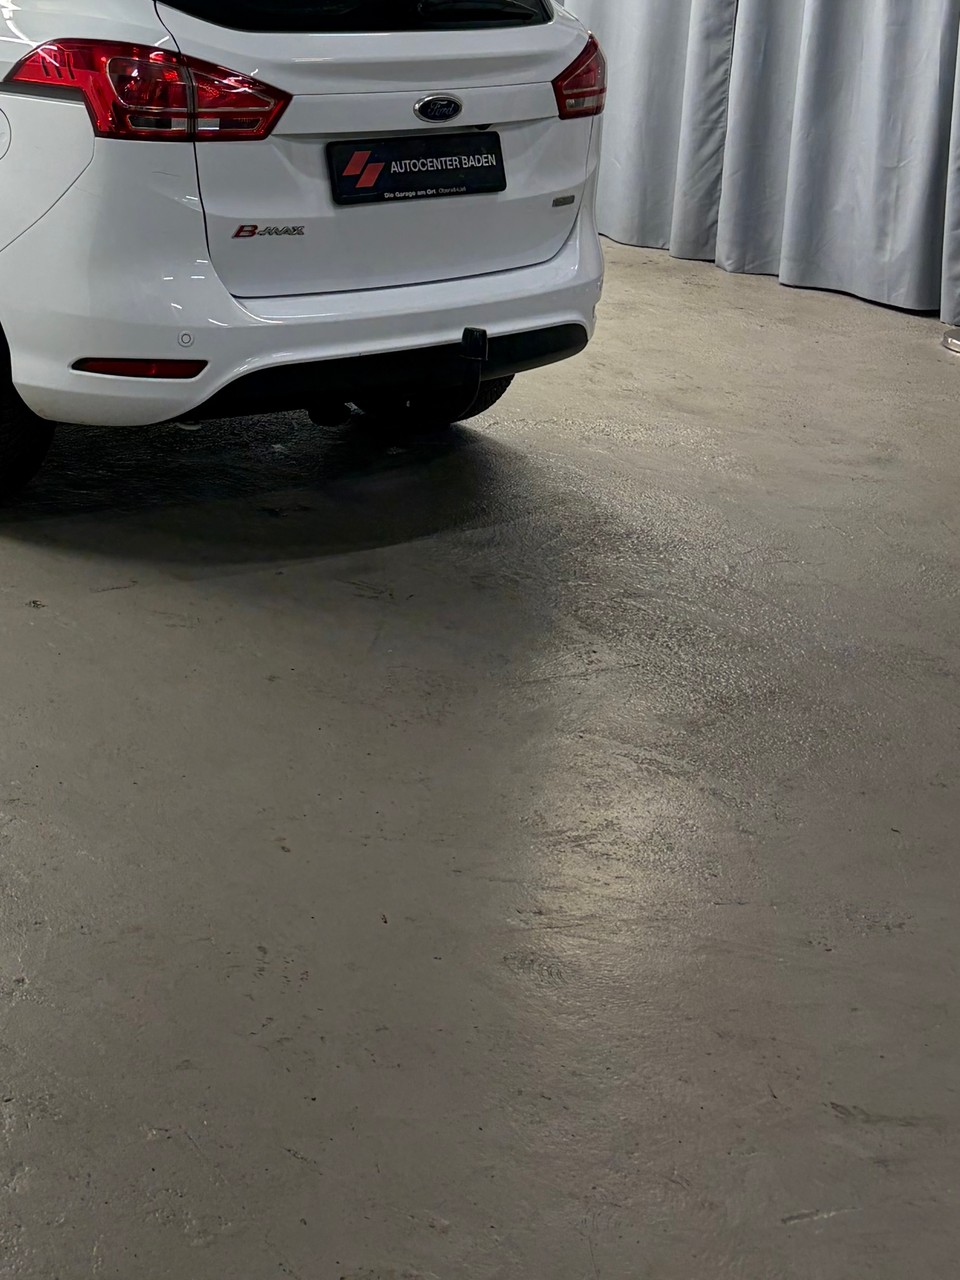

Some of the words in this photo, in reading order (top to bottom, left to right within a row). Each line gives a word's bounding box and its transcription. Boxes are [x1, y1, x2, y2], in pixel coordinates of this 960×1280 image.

[427, 100, 454, 116] Ford
[390, 156, 460, 174] AUTOCENTER
[462, 154, 497, 168] BADEN
[231, 224, 305, 240] B-MAX
